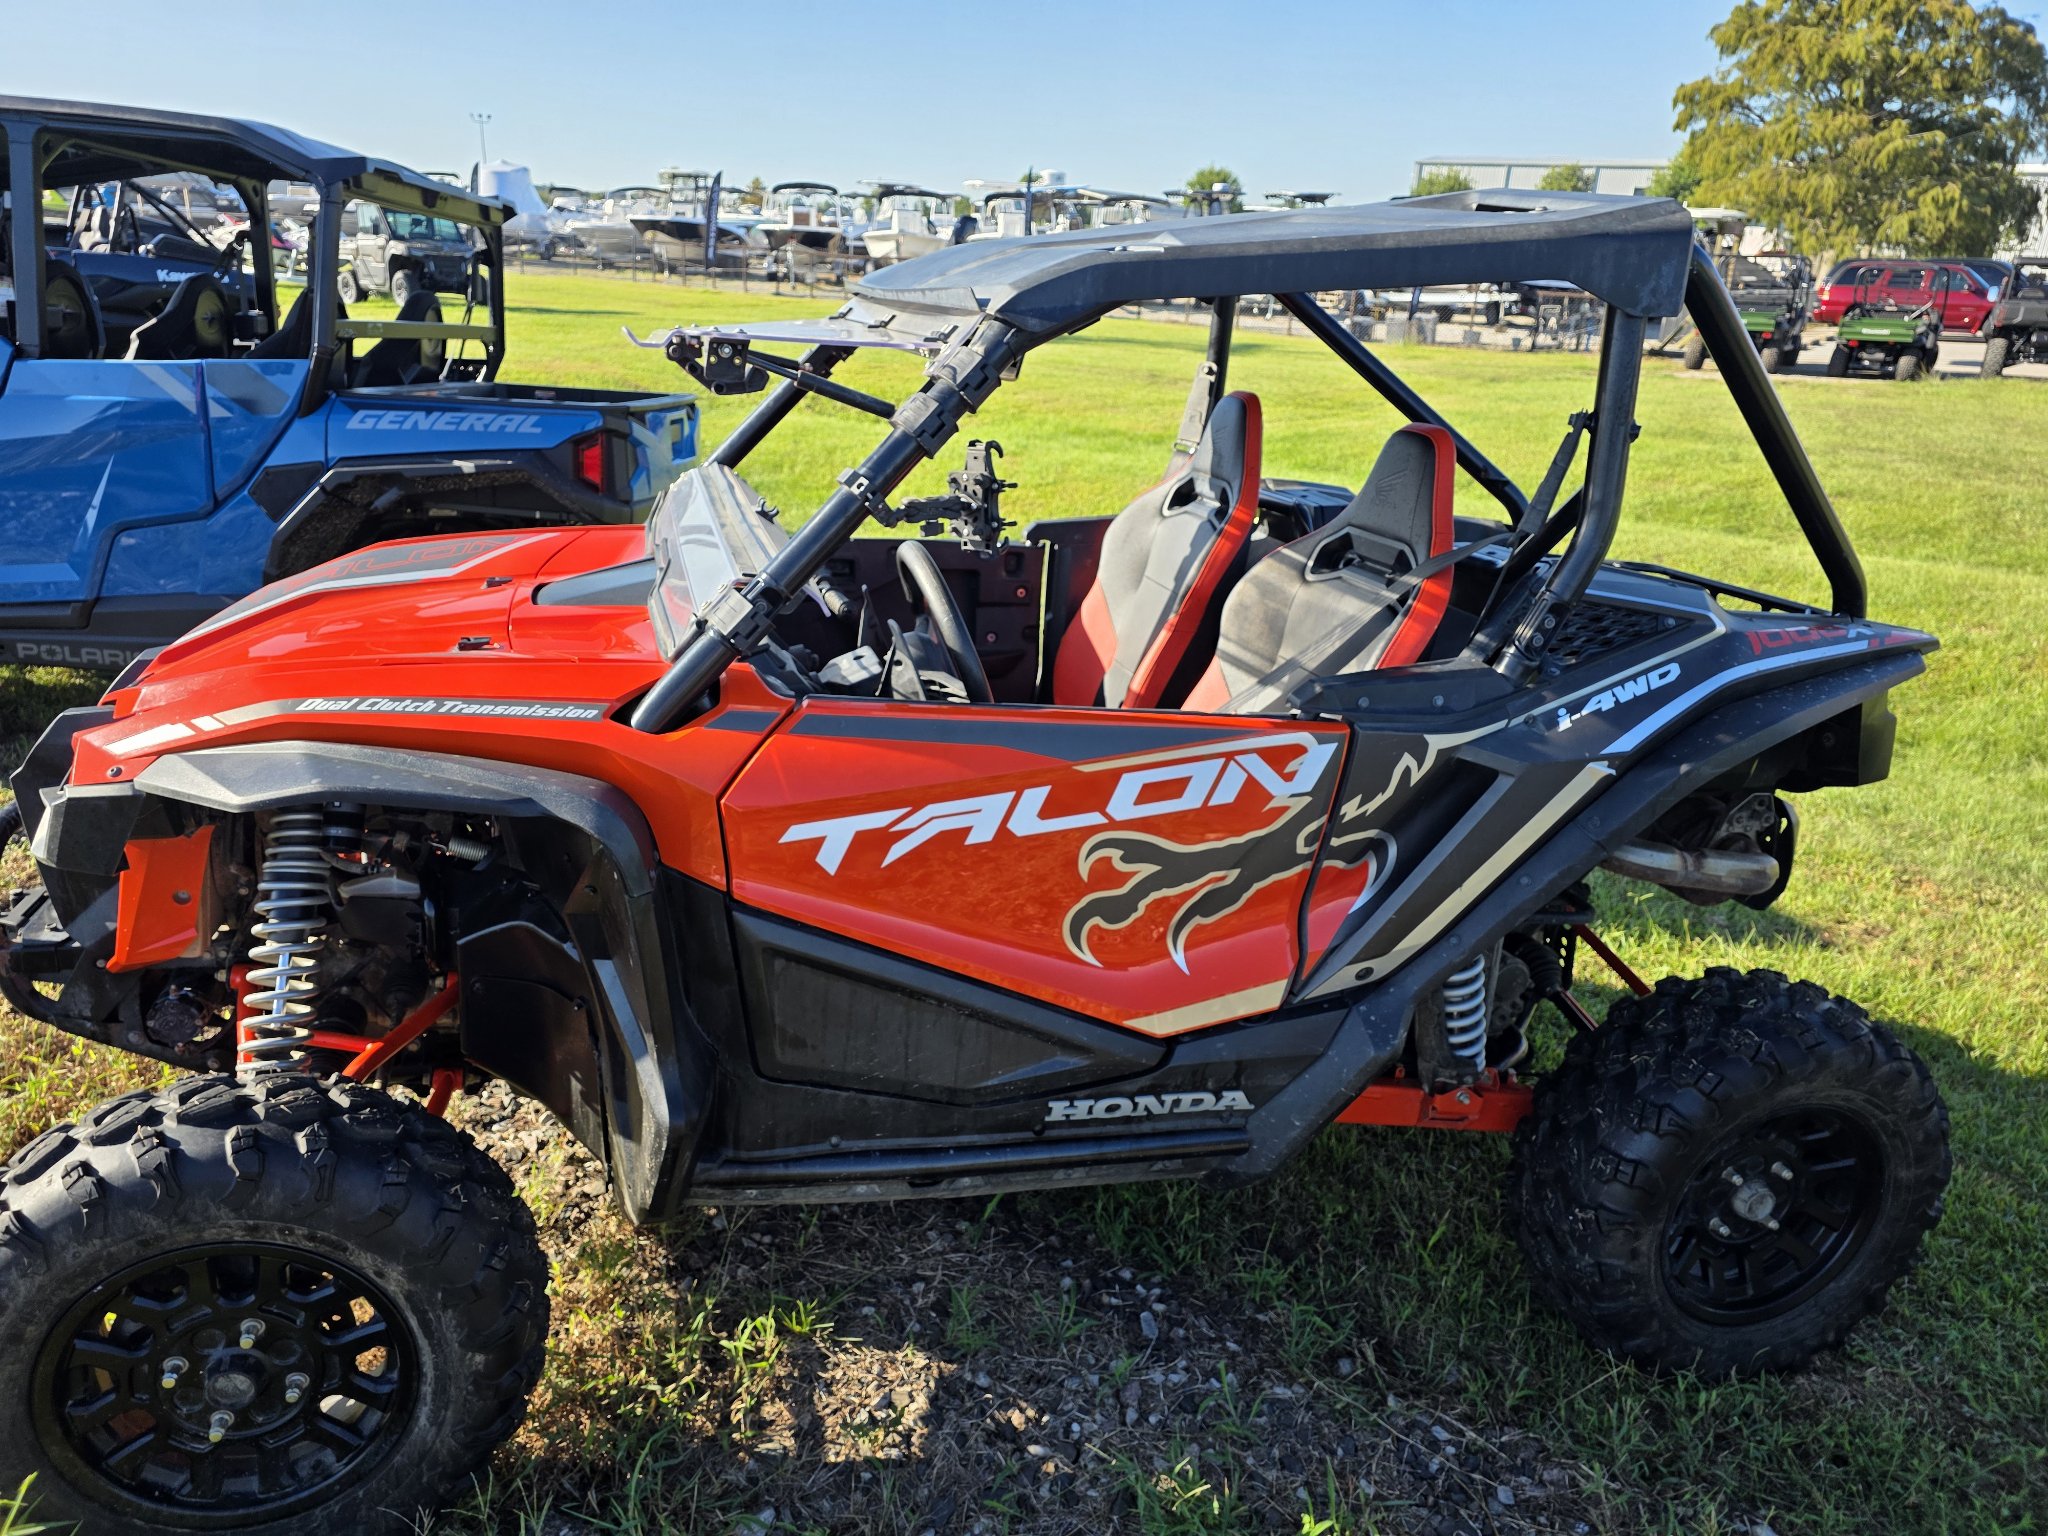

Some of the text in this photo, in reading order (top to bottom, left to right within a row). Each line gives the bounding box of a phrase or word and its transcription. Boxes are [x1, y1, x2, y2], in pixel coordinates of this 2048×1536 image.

[346, 409, 543, 434] GENERAL
[16, 642, 141, 666] POLARI
[295, 698, 599, 720] Dual Clutch Transmission
[1557, 662, 1682, 733] i-4WD
[778, 742, 1338, 877] TALON
[1044, 1089, 1255, 1122] HONDA
